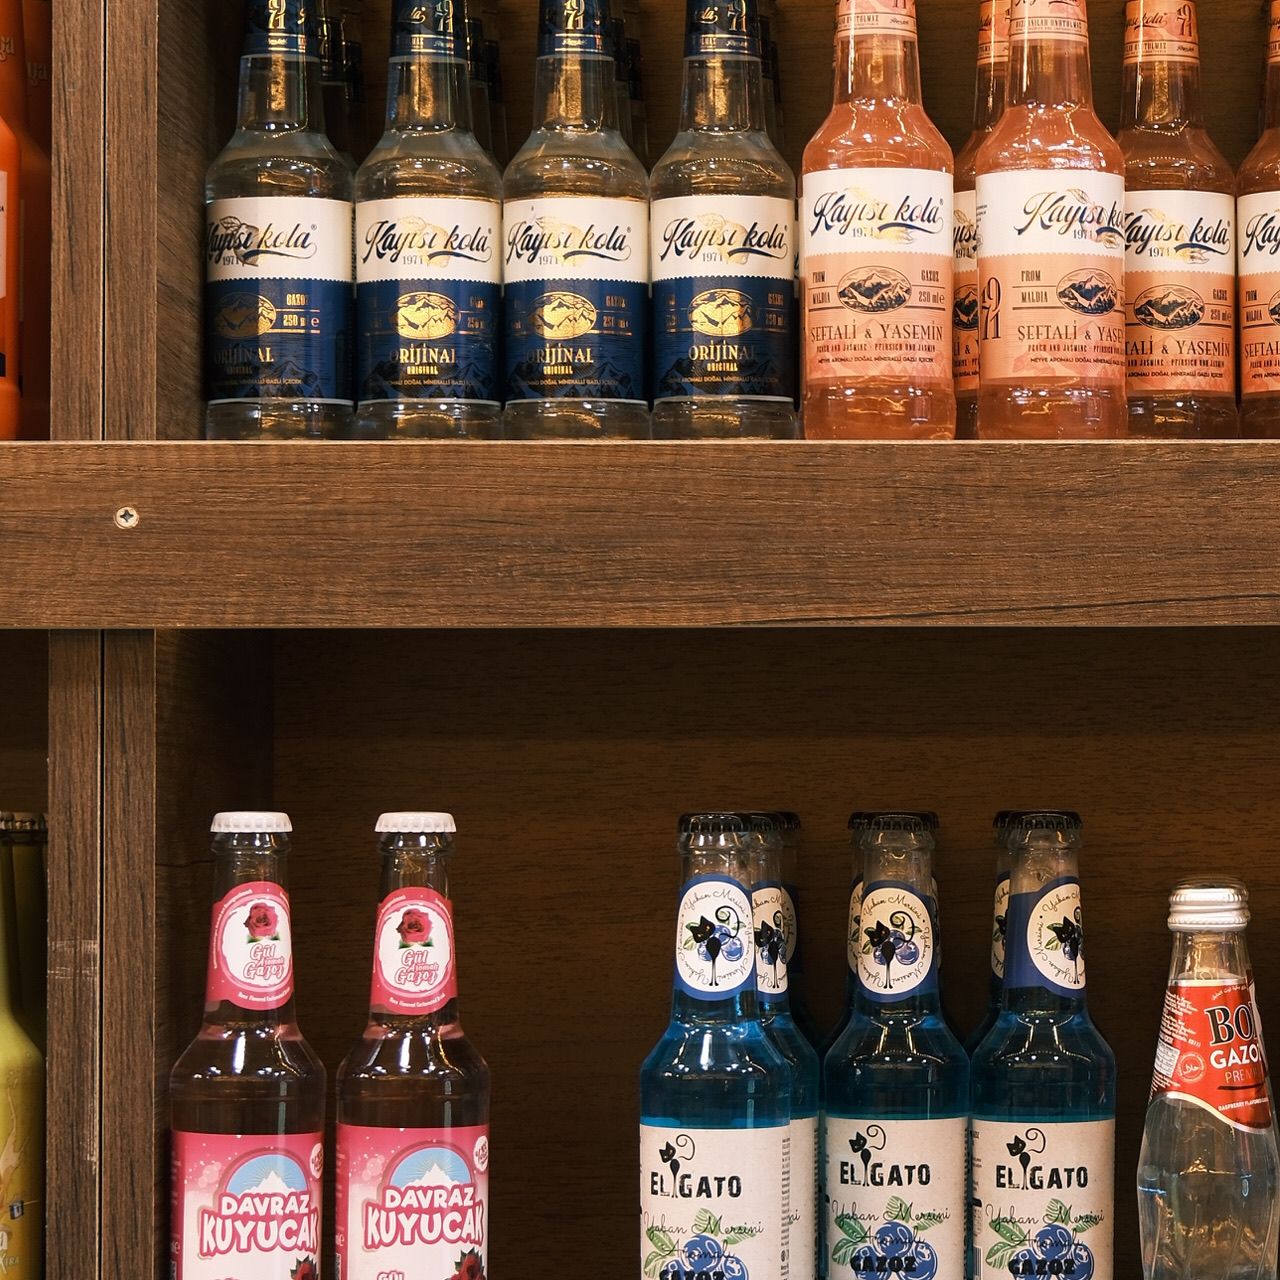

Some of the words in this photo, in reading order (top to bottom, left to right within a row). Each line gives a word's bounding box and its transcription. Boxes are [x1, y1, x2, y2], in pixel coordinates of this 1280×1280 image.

[893, 196, 944, 230] kola
[580, 224, 632, 259] kola
[743, 221, 788, 256] kola
[1021, 271, 1041, 281] FROM
[880, 320, 943, 342] YASEMİN
[1176, 337, 1230, 356] YASEMİN
[650, 1174, 673, 1198] EL
[678, 1175, 742, 1198] GATO
[869, 1163, 931, 1187] GATO
[385, 1187, 475, 1208] DAVRAZ
[367, 1205, 483, 1246] KUYUCAK
[850, 1256, 917, 1272] GAZOZ
